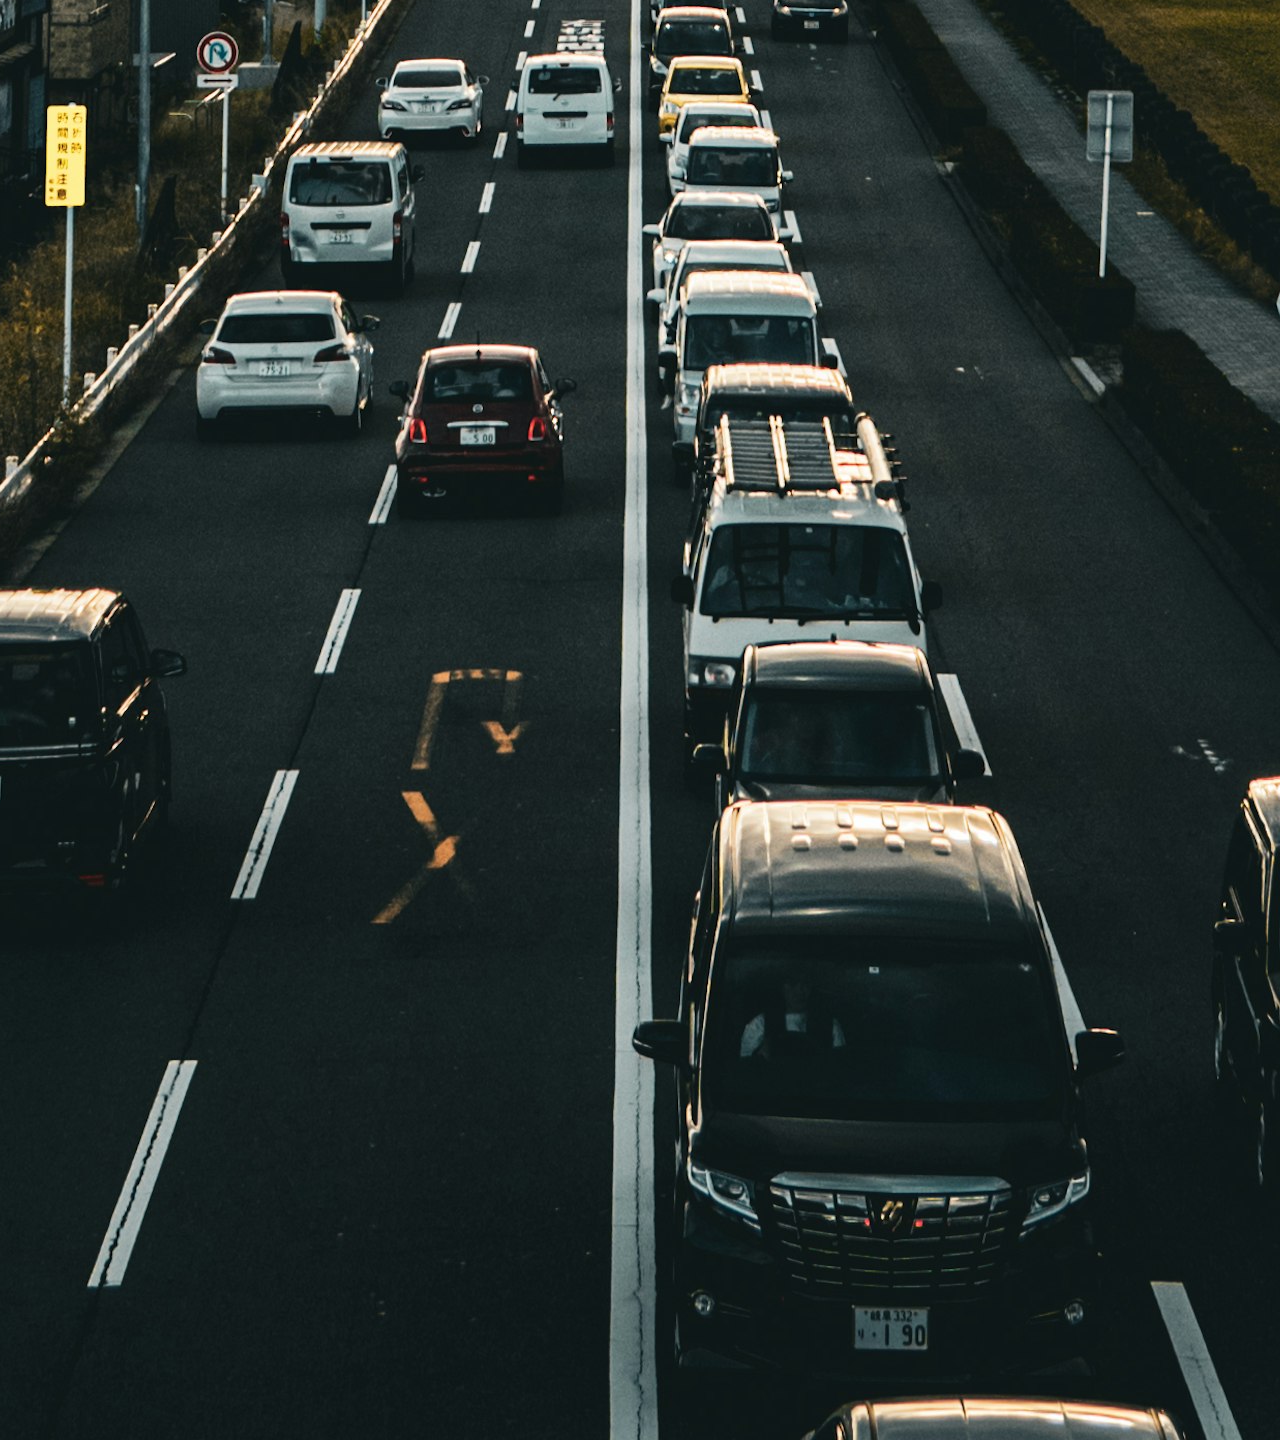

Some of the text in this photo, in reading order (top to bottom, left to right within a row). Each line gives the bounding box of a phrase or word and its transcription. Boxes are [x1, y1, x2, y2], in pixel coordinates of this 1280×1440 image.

[56, 112, 69, 201] 時間規制注意
[70, 112, 83, 154] 右折時
